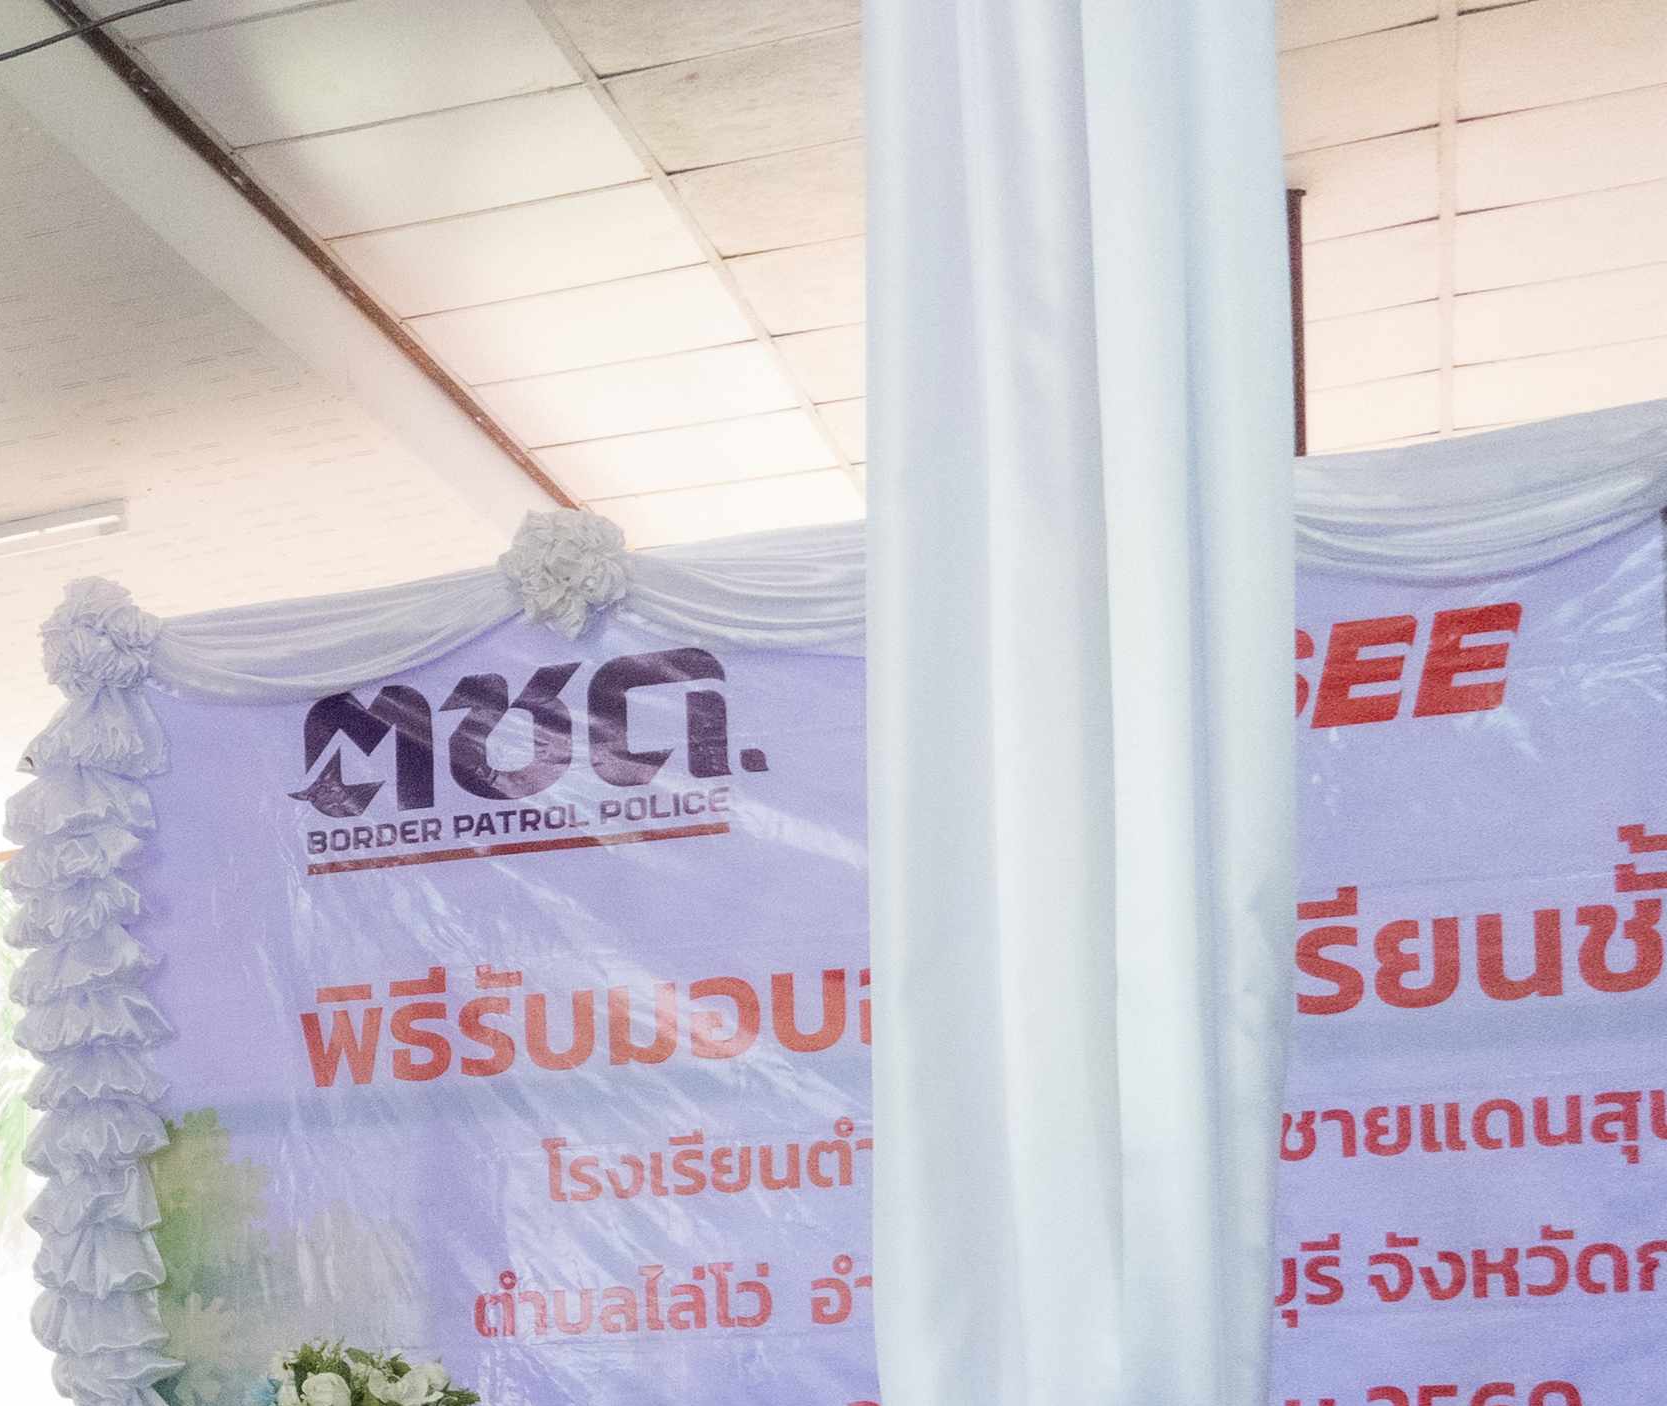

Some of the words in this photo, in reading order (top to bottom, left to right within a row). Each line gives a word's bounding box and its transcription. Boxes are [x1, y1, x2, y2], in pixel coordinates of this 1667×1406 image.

[1295, 602, 1523, 729] EE
[307, 817, 443, 855] BORDER
[453, 803, 590, 838] PATROL
[599, 785, 732, 825] POLICE
[299, 964, 872, 1088] พิธีรับมอบ
